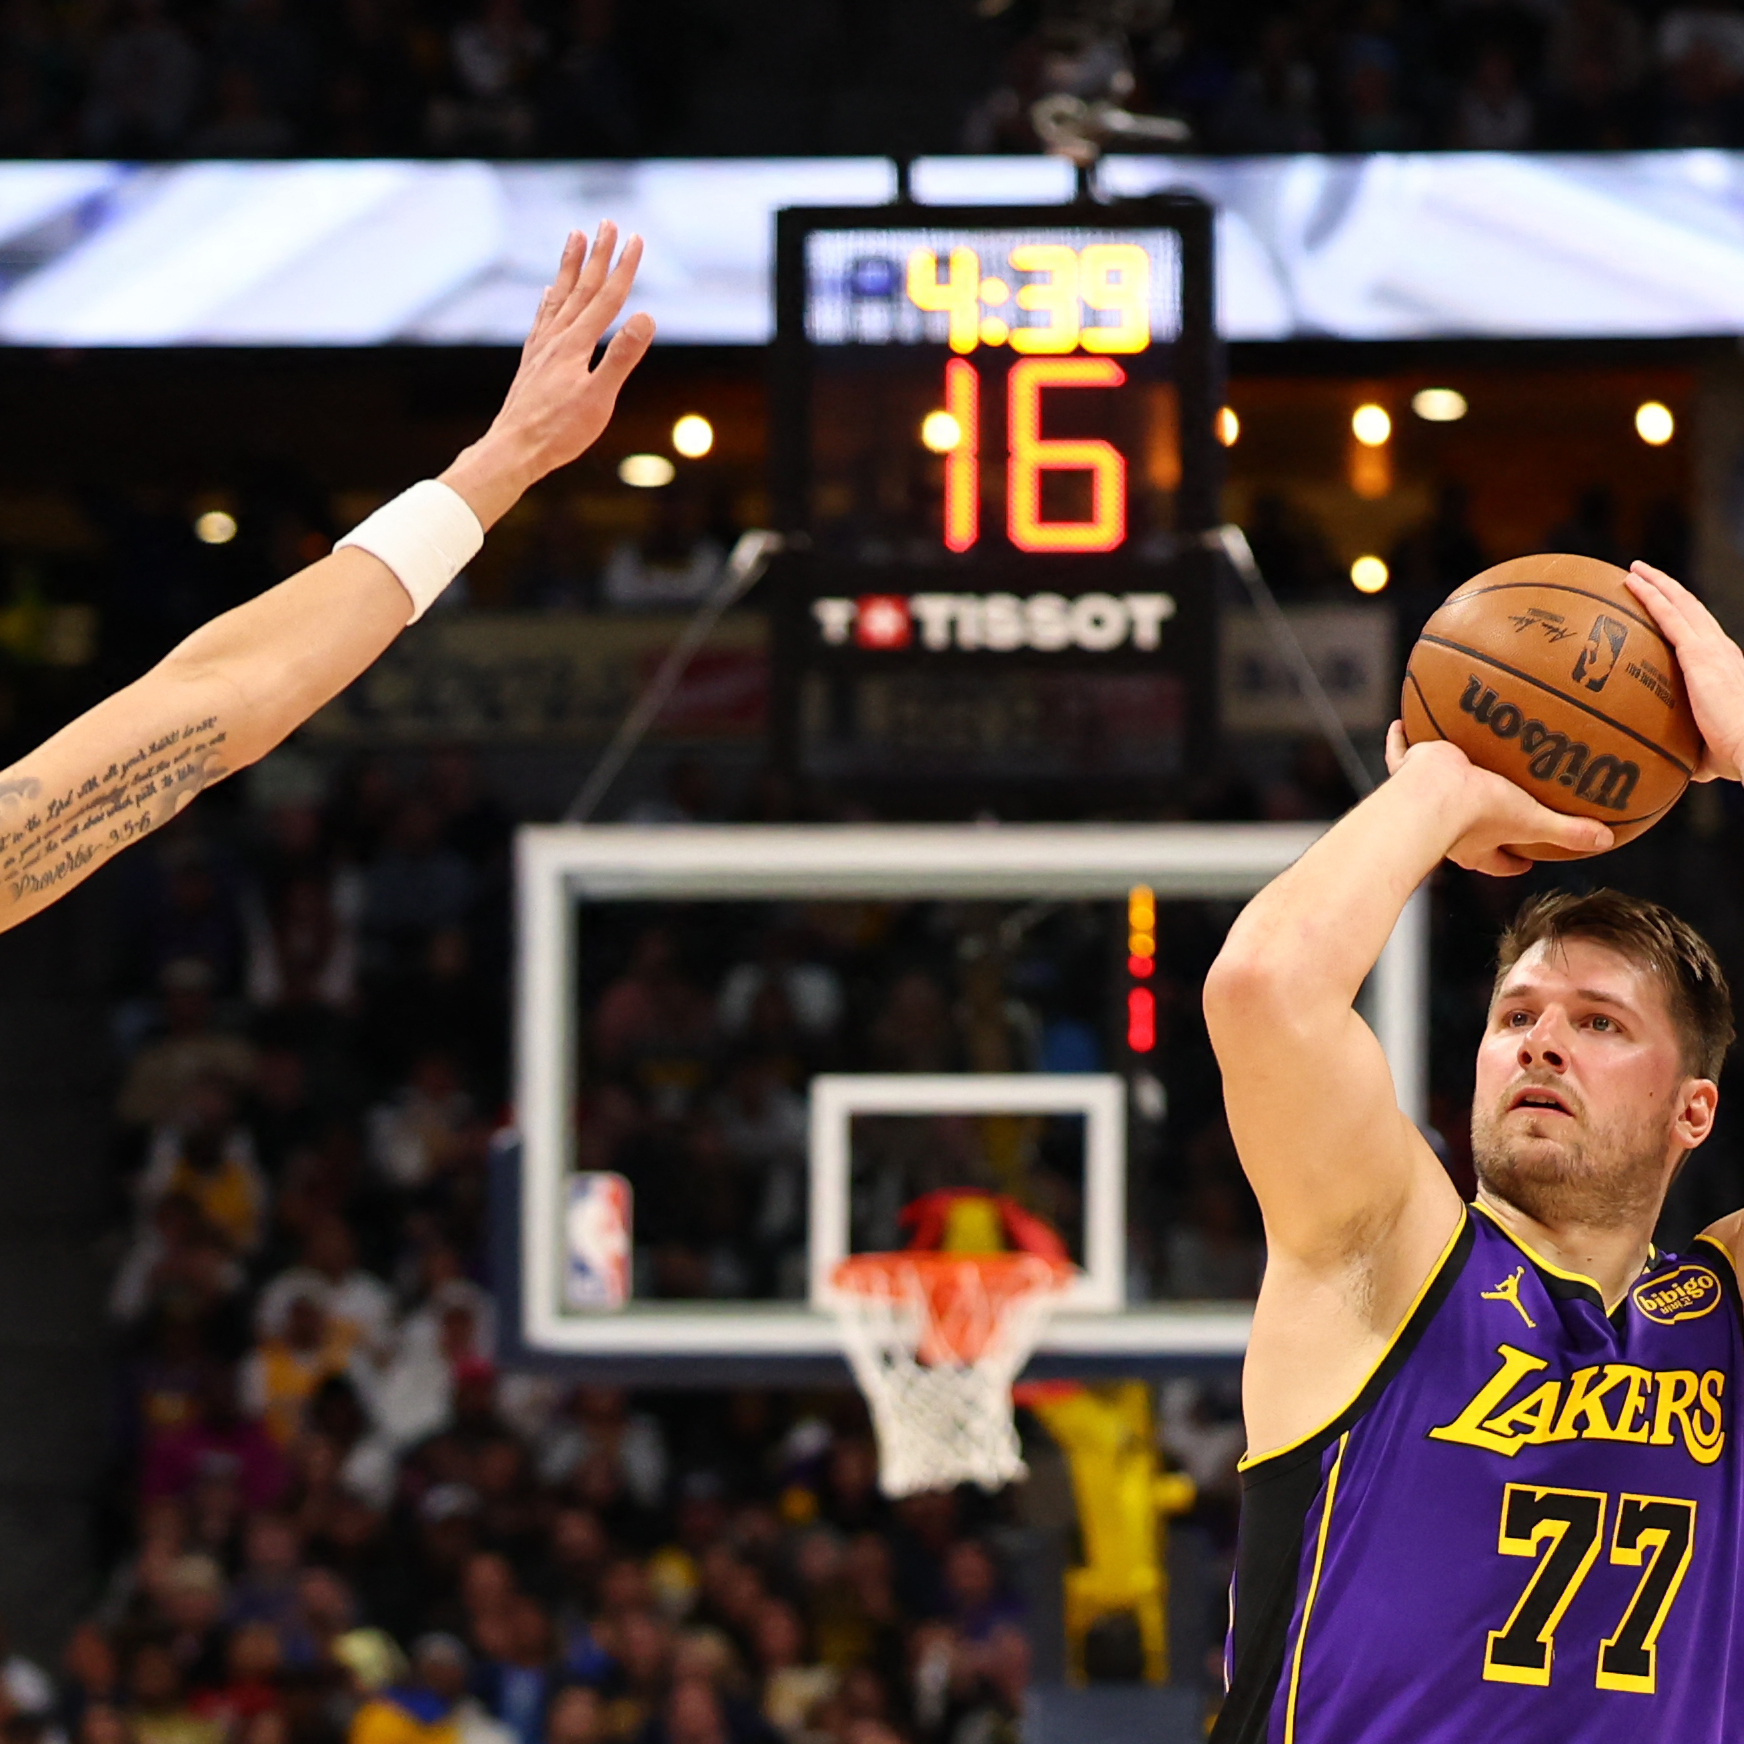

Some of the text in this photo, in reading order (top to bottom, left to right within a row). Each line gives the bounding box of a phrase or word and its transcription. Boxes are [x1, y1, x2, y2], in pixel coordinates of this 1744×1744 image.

[906, 244, 1151, 354] 4:39
[944, 357, 1127, 553] 16
[911, 594, 1176, 652] TISSOT
[1459, 674, 1642, 812] Wilson
[1638, 1275, 1714, 1311] bibigo
[1428, 1342, 1725, 1465] LAKERS
[1482, 1481, 1698, 1695] 77
